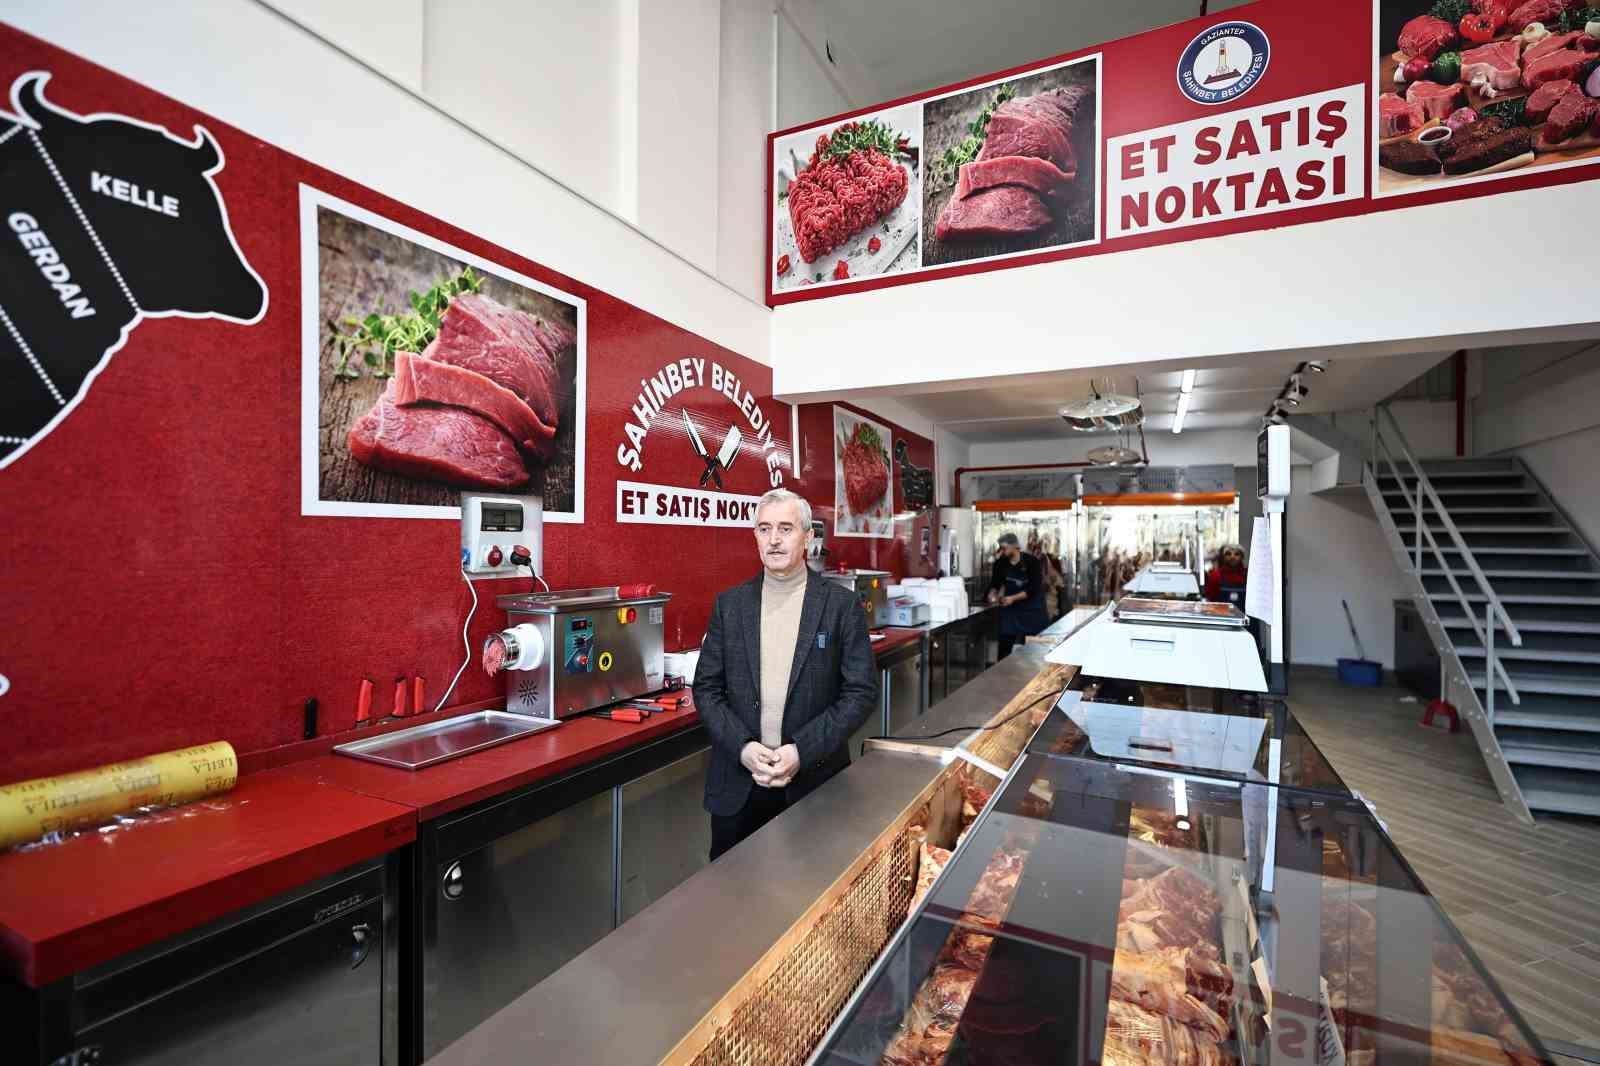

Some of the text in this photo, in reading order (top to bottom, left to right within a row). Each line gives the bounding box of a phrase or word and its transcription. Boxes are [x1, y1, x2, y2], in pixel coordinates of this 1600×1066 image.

[1121, 100, 1348, 181] ET SATIŞ
[91, 171, 179, 218] KELLE
[1121, 155, 1346, 231] NOKTASI
[8, 211, 96, 320] GERDAN
[617, 357, 705, 472] ŞAHİNBEY
[621, 489, 649, 515] ET
[656, 492, 711, 523] SATIŞ
